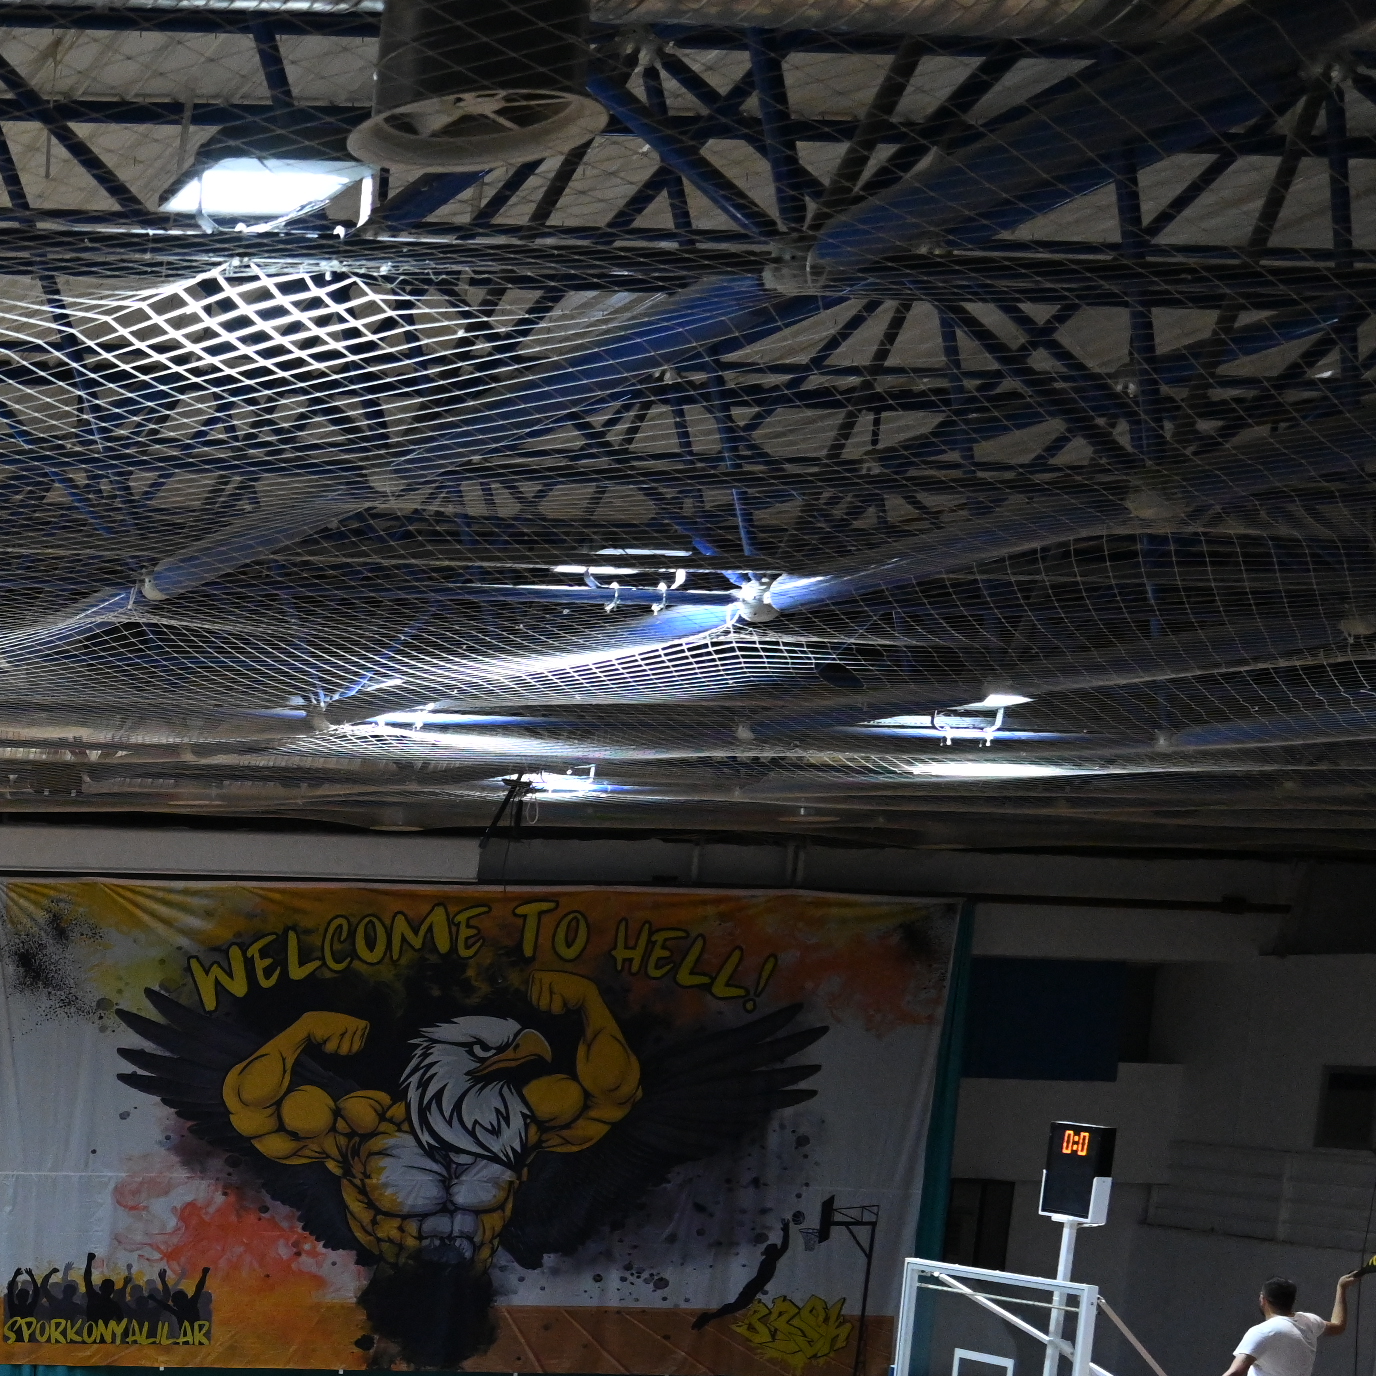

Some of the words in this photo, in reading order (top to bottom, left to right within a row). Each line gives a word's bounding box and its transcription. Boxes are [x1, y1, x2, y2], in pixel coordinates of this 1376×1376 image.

[187, 902, 491, 1013] WELCOME
[513, 900, 588, 962] TO
[611, 917, 780, 1013] HELL!
[1062, 1130, 1090, 1156] 0:0
[3, 1316, 211, 1346] SPORKONYALILAR
